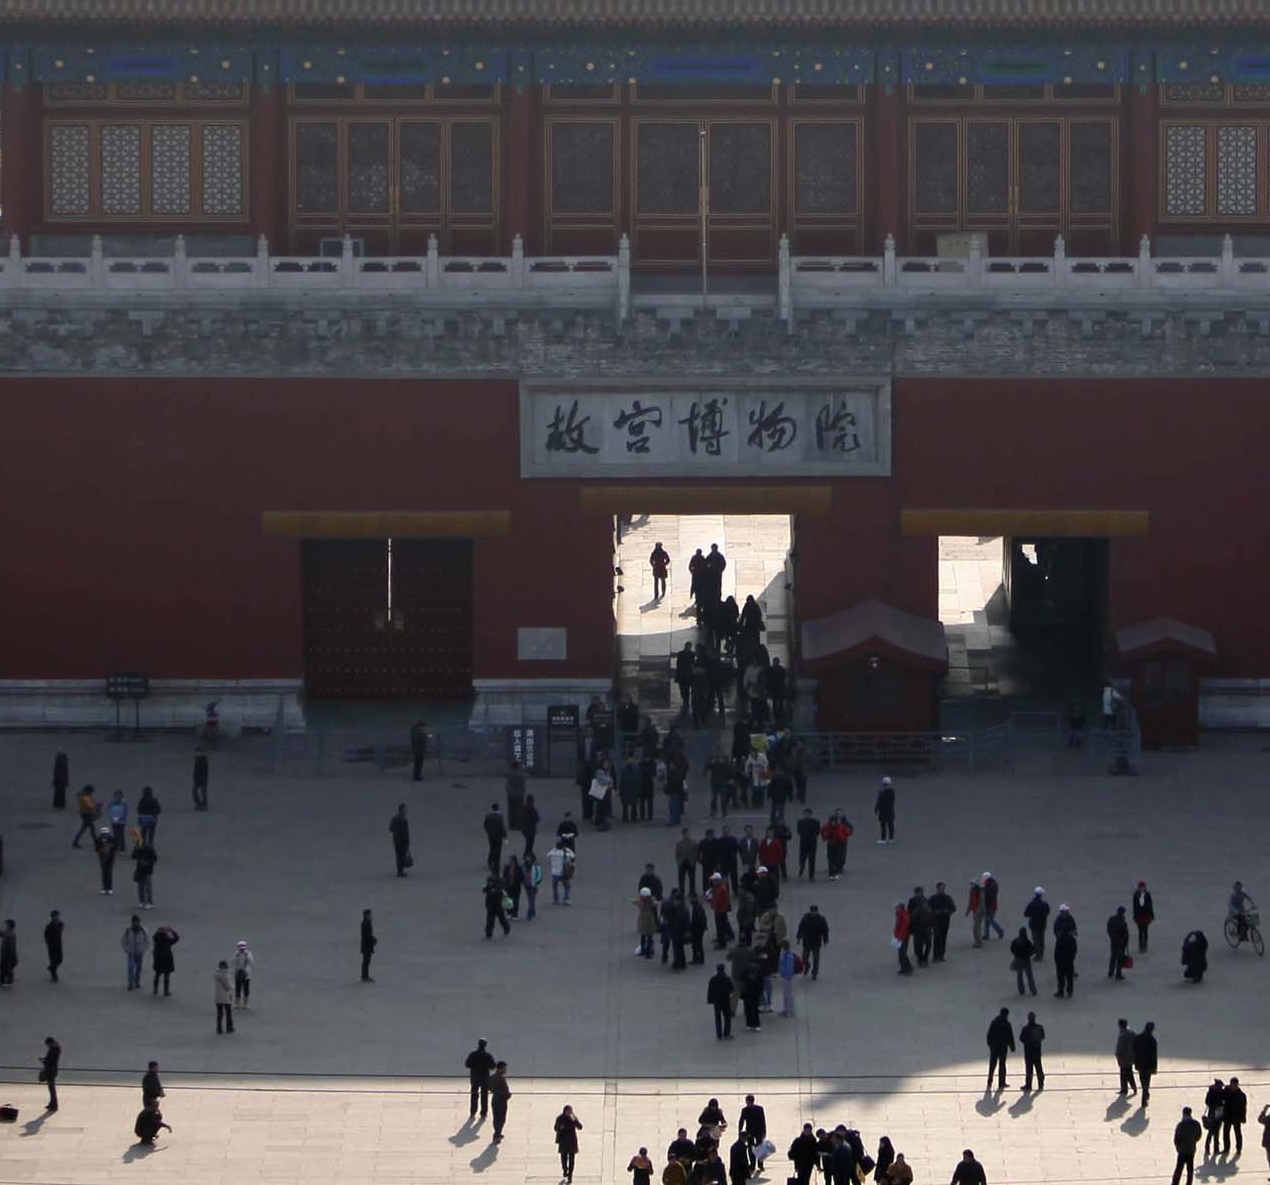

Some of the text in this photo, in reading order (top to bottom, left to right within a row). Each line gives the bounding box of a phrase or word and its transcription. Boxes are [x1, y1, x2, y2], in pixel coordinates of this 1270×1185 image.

[546, 398, 861, 455] 故宫博物院
